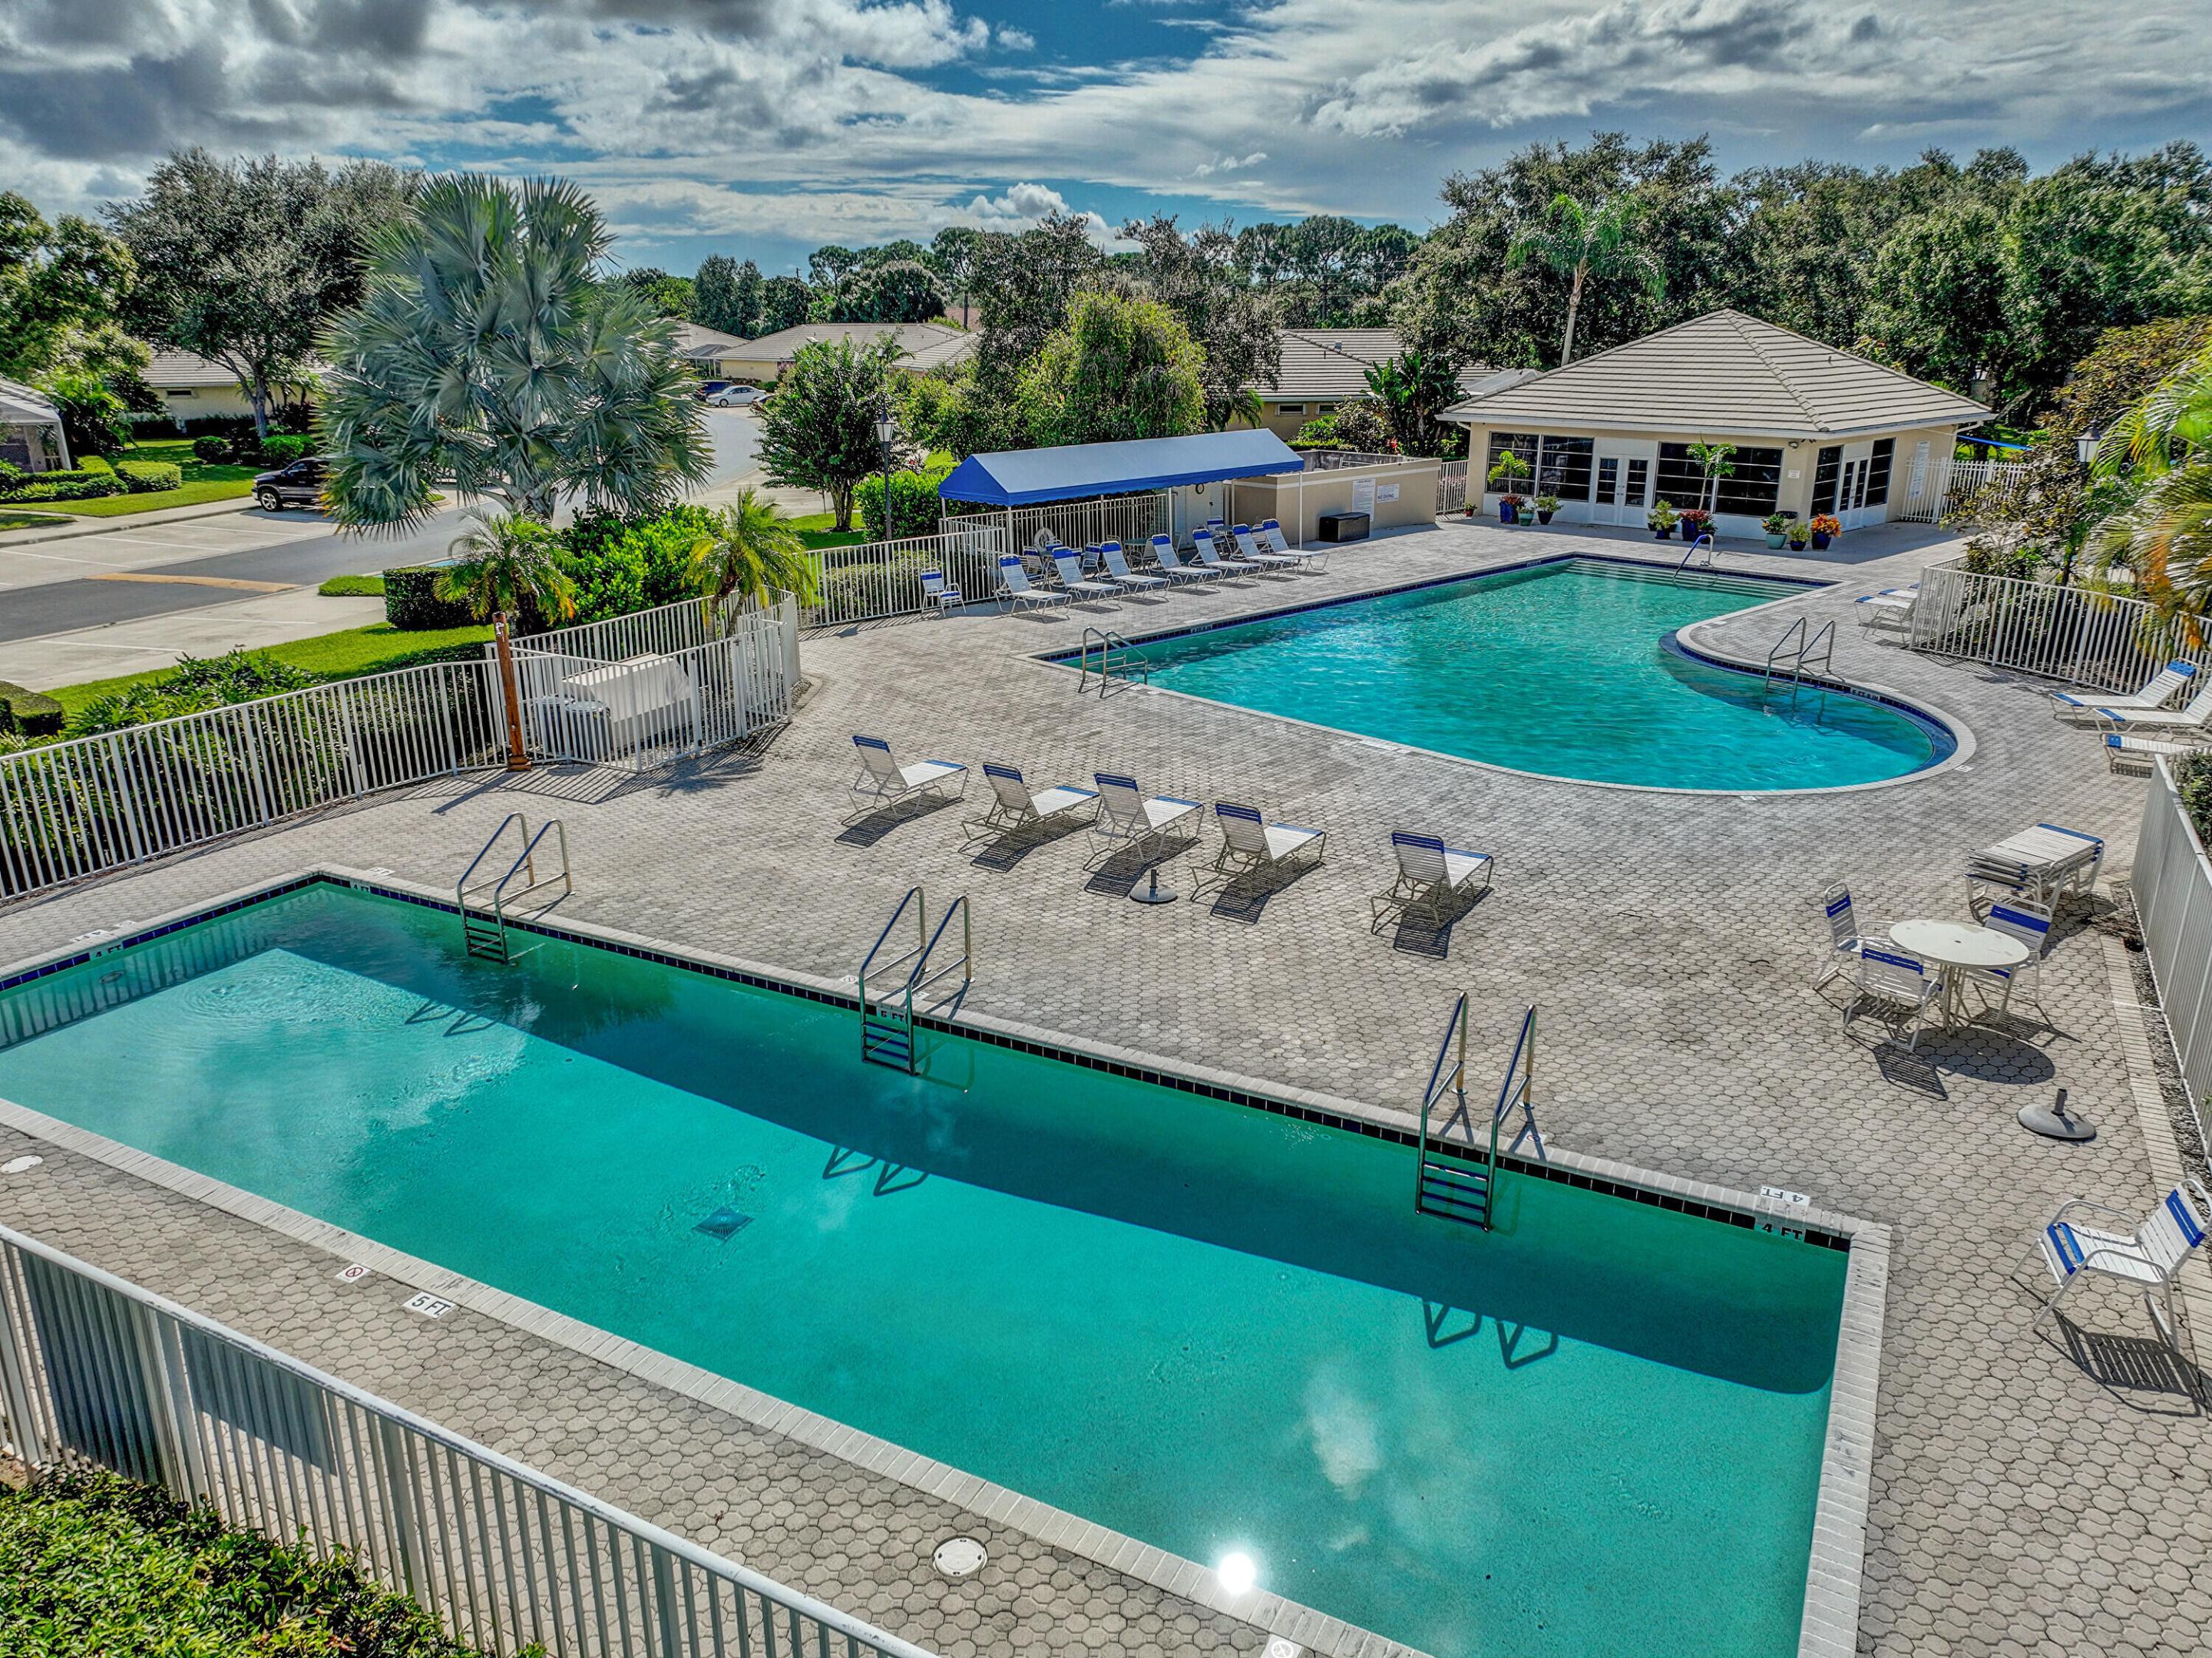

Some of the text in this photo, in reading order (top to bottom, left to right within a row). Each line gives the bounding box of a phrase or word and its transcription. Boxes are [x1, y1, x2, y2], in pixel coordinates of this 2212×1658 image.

[107, 944, 121, 954] FT
[1791, 1194, 1804, 1203] 4
[1761, 1223, 1803, 1240] 4 FT
[411, 1295, 431, 1308] 5
